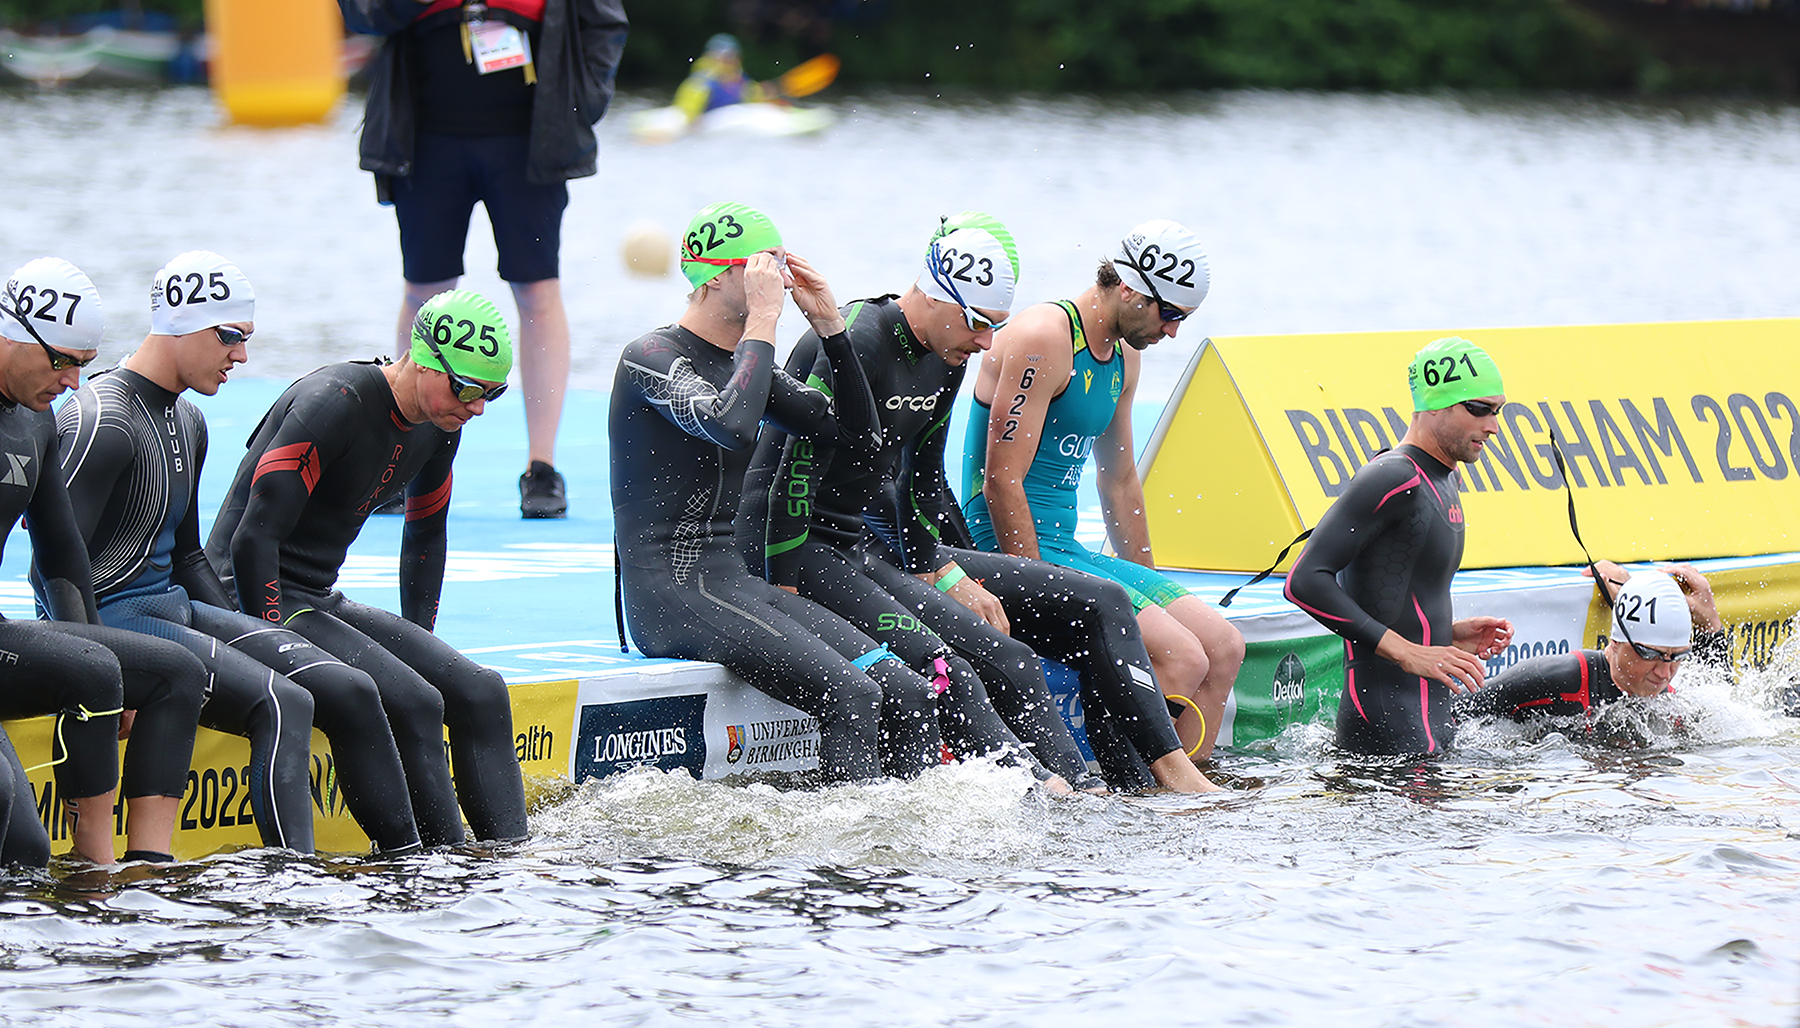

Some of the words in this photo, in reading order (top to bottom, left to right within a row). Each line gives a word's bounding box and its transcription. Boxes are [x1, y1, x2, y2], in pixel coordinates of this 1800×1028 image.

[686, 214, 744, 259] 623
[938, 248, 995, 287] 623
[1139, 243, 1196, 289] 622
[15, 284, 82, 326] 627
[166, 272, 231, 308] 625
[433, 313, 500, 358] 625
[1424, 353, 1479, 387] 621
[885, 395, 938, 412] orca
[1001, 366, 1036, 441] 622
[164, 406, 183, 473] HUUB
[1615, 593, 1657, 625] 621
[1273, 678, 1304, 701] Dettol
[593, 726, 688, 763] LONGINES
